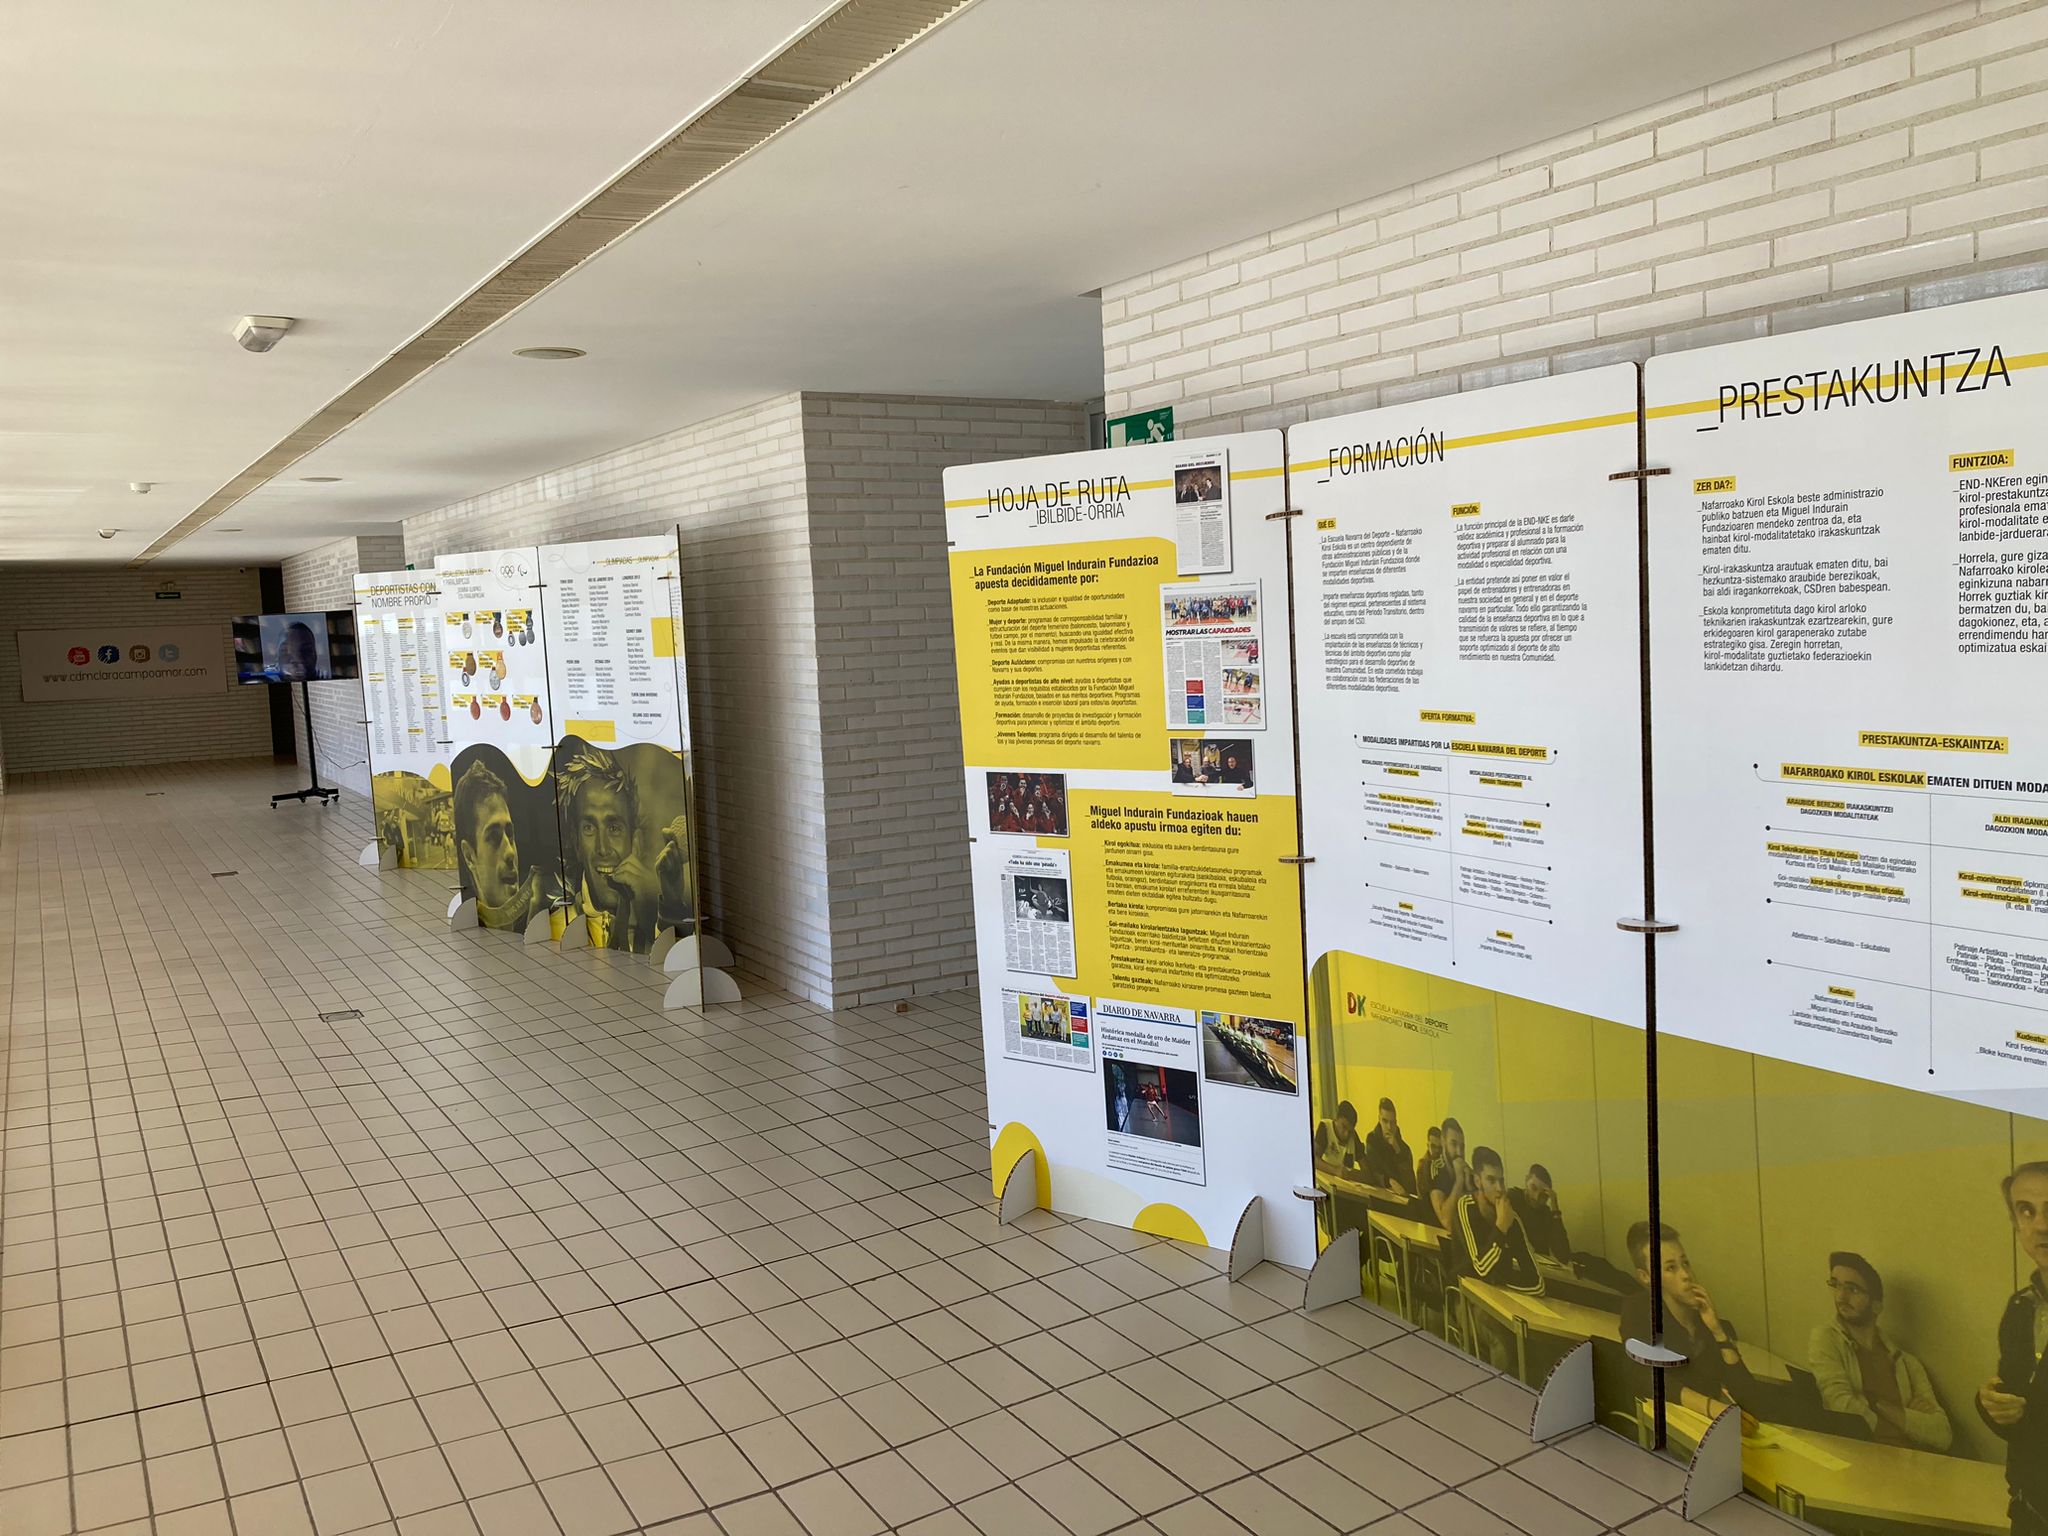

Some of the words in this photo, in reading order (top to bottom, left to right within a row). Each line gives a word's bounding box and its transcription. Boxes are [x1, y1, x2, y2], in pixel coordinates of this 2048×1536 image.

[1952, 454, 2008, 468] FUNTZIOA:
[1045, 482, 1070, 508] DE
[1078, 476, 1130, 504] RUTA
[1696, 481, 1712, 492] ZER
[1713, 479, 1732, 490] DA?:
[1746, 496, 1765, 506] Kirol
[1766, 494, 1794, 505] Eskola
[1796, 492, 1820, 503] beste
[1822, 488, 1884, 501] administrazio
[1701, 511, 1730, 523] publiko
[1731, 509, 1764, 519] batzuen
[1765, 507, 1779, 517] eta
[1781, 505, 1810, 517] Miguel
[1812, 503, 1848, 514] Indurain
[1958, 503, 2020, 517] profesionala
[1701, 522, 1754, 532] Fundazioaren
[1756, 518, 1794, 529] mendeko
[1796, 516, 1829, 527] zentroa
[1830, 515, 1845, 525] da,
[1846, 514, 1862, 524] eta
[1959, 515, 2039, 528] kirol-modalitate
[1701, 534, 1731, 544] hainbat
[1732, 529, 1816, 542] kirol-modalitatetako
[1818, 525, 1880, 537] irakaskuntzak
[1702, 546, 1731, 555] ematen
[1732, 544, 1751, 553] ditu.
[1776, 560, 1814, 571] arautuak
[1814, 559, 1849, 570] ematen
[1850, 558, 1871, 568] ditu,
[1873, 557, 1888, 567] bai
[2000, 552, 2024, 564] gure
[985, 563, 1031, 575] Fundación
[1033, 560, 1064, 574] Miguel
[1066, 558, 1106, 570] Indurain
[1108, 555, 1158, 567] Fundazioa
[1958, 565, 2014, 576] Nafarroako
[974, 578, 1009, 591] apuesta
[1010, 575, 1078, 587] decididamente
[1079, 574, 1099, 585] por:
[1702, 574, 1787, 585] hezkuntza-sistemako
[1788, 572, 1826, 582] araubide
[1828, 570, 1880, 581] berezikoak,
[1958, 578, 2012, 590] eginkizuna
[1702, 587, 1715, 596] bai
[1716, 586, 1731, 596] aldi
[1732, 585, 1801, 597] iragankorrekoak,
[1803, 584, 1836, 594] CSDren
[1838, 583, 1891, 593] babespean.
[1958, 591, 1992, 602] Horrek
[1994, 590, 2032, 602] guztiak
[372, 597, 402, 608] NOMBRE
[405, 596, 431, 606] PROPIO
[1730, 605, 1791, 615] konprometituta
[1793, 604, 1815, 616] dago
[1816, 604, 1836, 614] kirol
[1838, 603, 1867, 613] arloko
[1702, 617, 1746, 626] teknikarien
[1748, 616, 1806, 626] irakaskuntzak
[1807, 616, 1869, 625] ezartzearekin,
[1871, 616, 1893, 627] gure
[1207, 626, 1251, 634] CAPACIDADES
[1702, 628, 1754, 639] erkidegoaren
[1756, 627, 1774, 637] kirol
[1776, 628, 1835, 639] garapenerako
[1836, 627, 1867, 637] zutabe
[1703, 639, 1747, 650] estrategiko
[1748, 639, 1768, 650] gisa.
[1769, 639, 1801, 650] Zeregin
[1803, 639, 1843, 649] horretan,
[1703, 650, 1765, 660] kirol-modalitate
[1766, 650, 1811, 662] guztietako
[1812, 651, 1872, 661] federazioekin
[1703, 662, 1748, 671] lankidetzan
[1749, 662, 1783, 672] dihardu.
[1420, 712, 1441, 720] OFERTA
[1430, 740, 1442, 748] POR
[1442, 741, 1450, 750] LA
[1450, 742, 1476, 751] ESCUELA
[1476, 744, 1504, 753] NAVARRA
[1505, 746, 1517, 755] DEL
[1518, 747, 1546, 757] DEPORTE
[1861, 734, 2004, 750] PRESTAKUNTZA-ESKAINTZA:
[1783, 766, 1844, 778] NAFARROAKO
[1846, 770, 1875, 781] KIROL
[1878, 772, 1924, 784] ESKOLAK
[1926, 776, 1970, 787] EMATEN
[1972, 779, 2012, 790] DITUEN
[1123, 807, 1164, 818] Indurain
[1166, 809, 1224, 821] Fundazioak
[1226, 811, 1258, 823] hauen
[1993, 815, 2010, 823] ALDI
[1090, 819, 1122, 830] aldeko
[1123, 821, 1157, 832] apustu
[1158, 822, 1188, 833] irmoa
[1190, 824, 1222, 836] egiten
[1224, 825, 1241, 836] du:
[1984, 824, 2025, 834] DAGOZKION
[1347, 992, 1366, 1017] DK
[1102, 1004, 1130, 1015] DIARIO
[1131, 1008, 1142, 1017] DE
[1143, 1009, 1181, 1023] NAVARRA
[1136, 1038, 1159, 1047] Mundial
